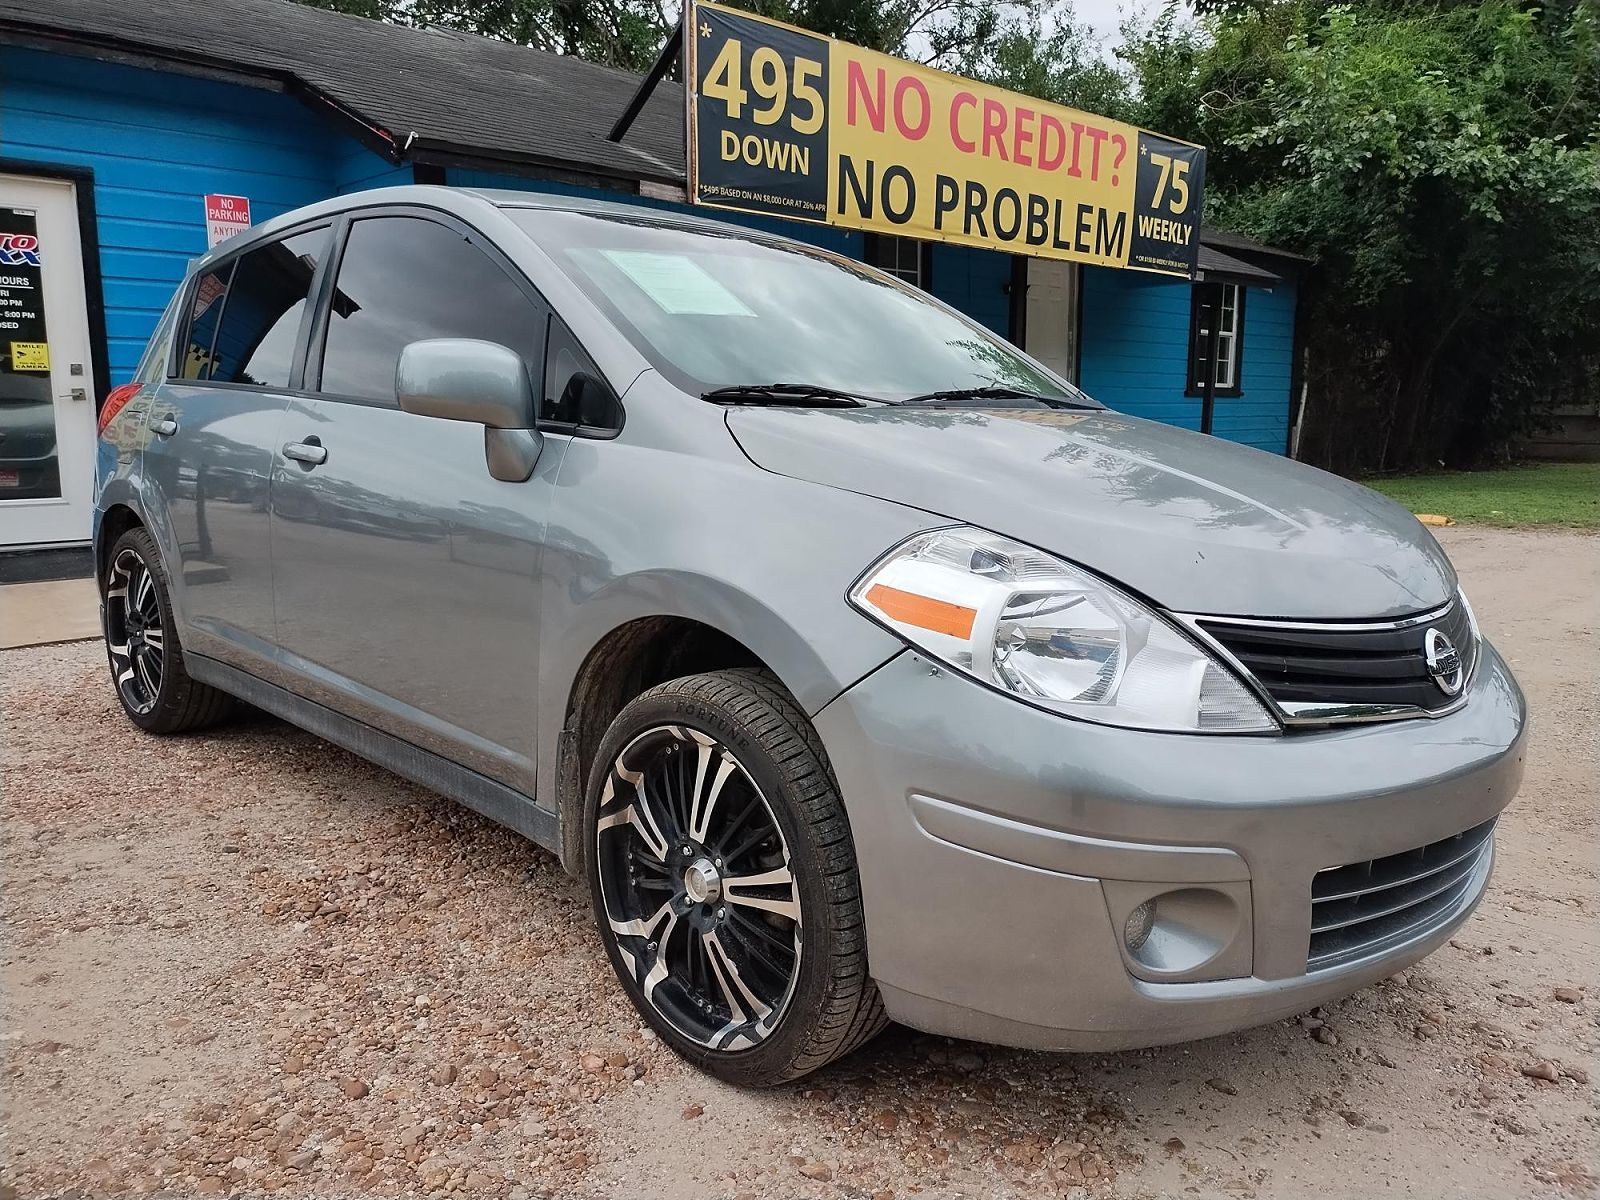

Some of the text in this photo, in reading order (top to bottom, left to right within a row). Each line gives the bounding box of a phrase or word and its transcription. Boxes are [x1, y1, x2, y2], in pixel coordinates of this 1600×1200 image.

[703, 38, 825, 135] 495
[848, 60, 1127, 187] NO CREDIT?
[721, 130, 810, 176] DOWN
[720, 187, 741, 198] BASED
[742, 191, 752, 200] ON
[753, 192, 763, 201] AN
[783, 198, 794, 207] CAR
[794, 200, 803, 208] AT
[815, 203, 826, 212] APR
[1151, 152, 1190, 215] 75
[209, 209, 248, 222] PARKING
[221, 198, 234, 210] NO
[837, 154, 1127, 259] NO PROBLEM
[1138, 214, 1193, 246] WEEKLY
[0, 276, 29, 286] OURS
[5, 311, 21, 319] 5:00
